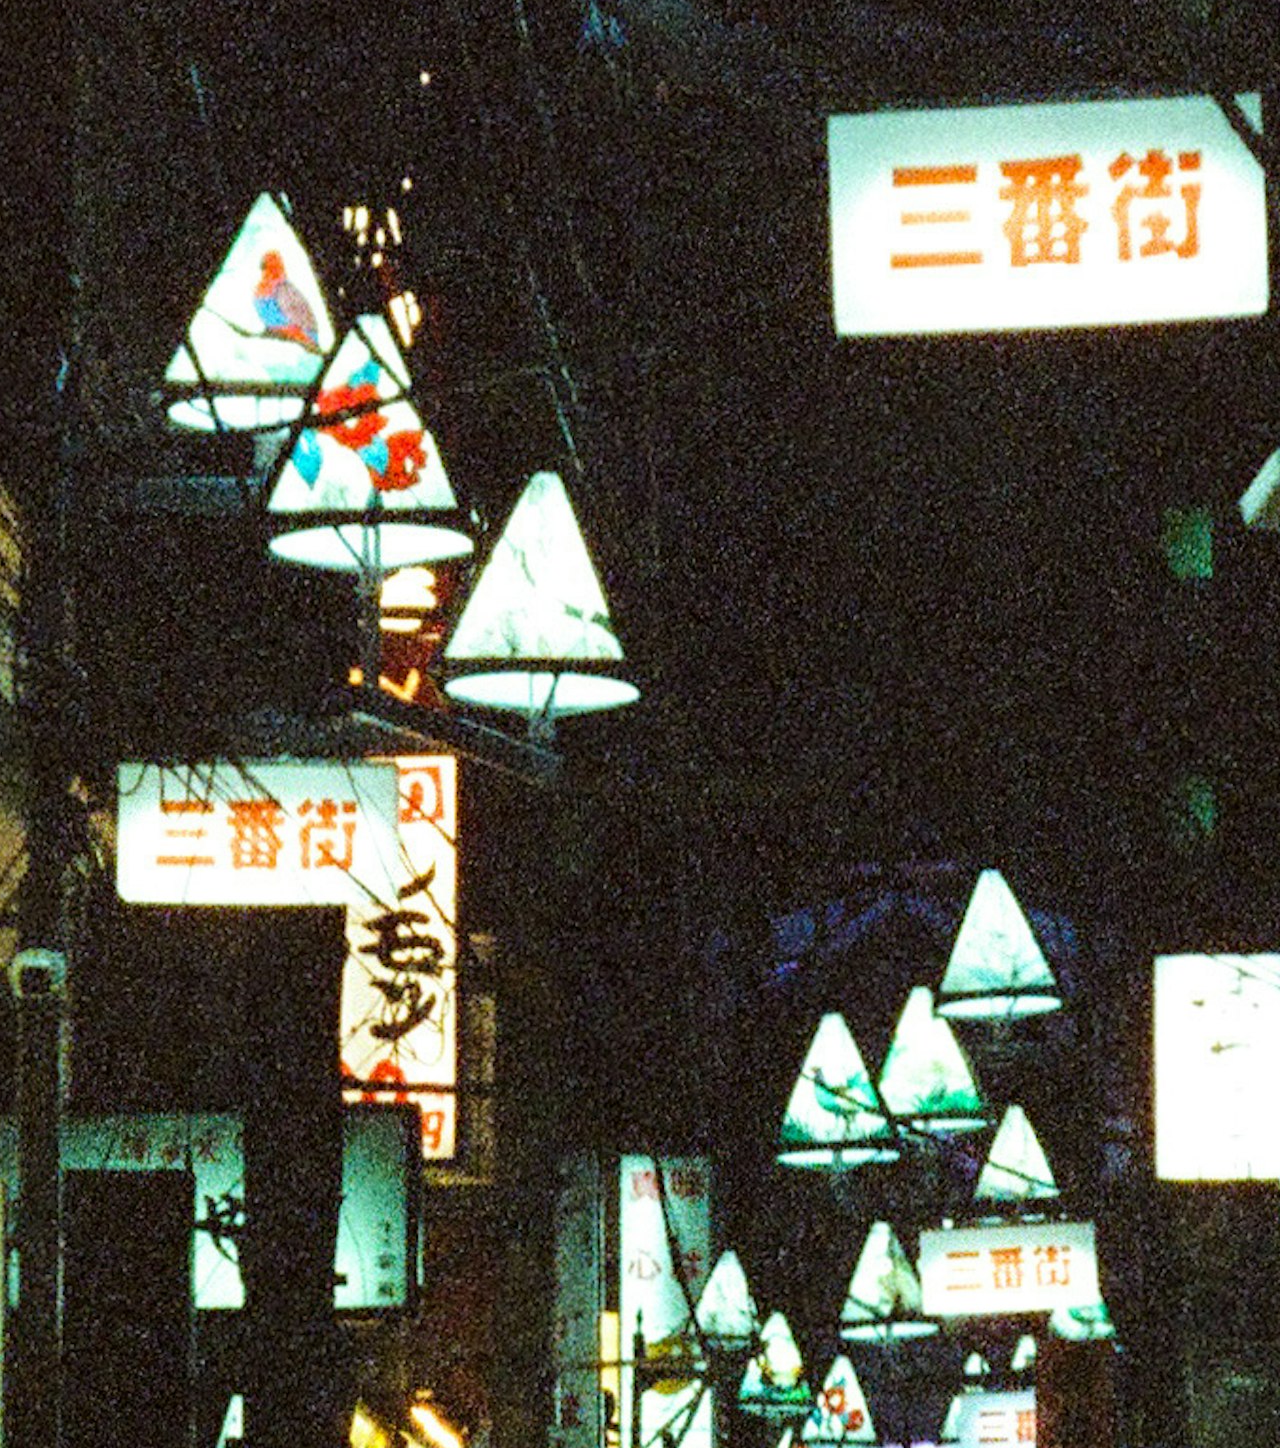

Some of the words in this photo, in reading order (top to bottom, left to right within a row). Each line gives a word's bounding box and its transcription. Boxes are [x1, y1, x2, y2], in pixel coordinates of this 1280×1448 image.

[888, 148, 1203, 270] 三番街
[154, 798, 359, 871] 三番街
[945, 1244, 1073, 1293] 三番街
